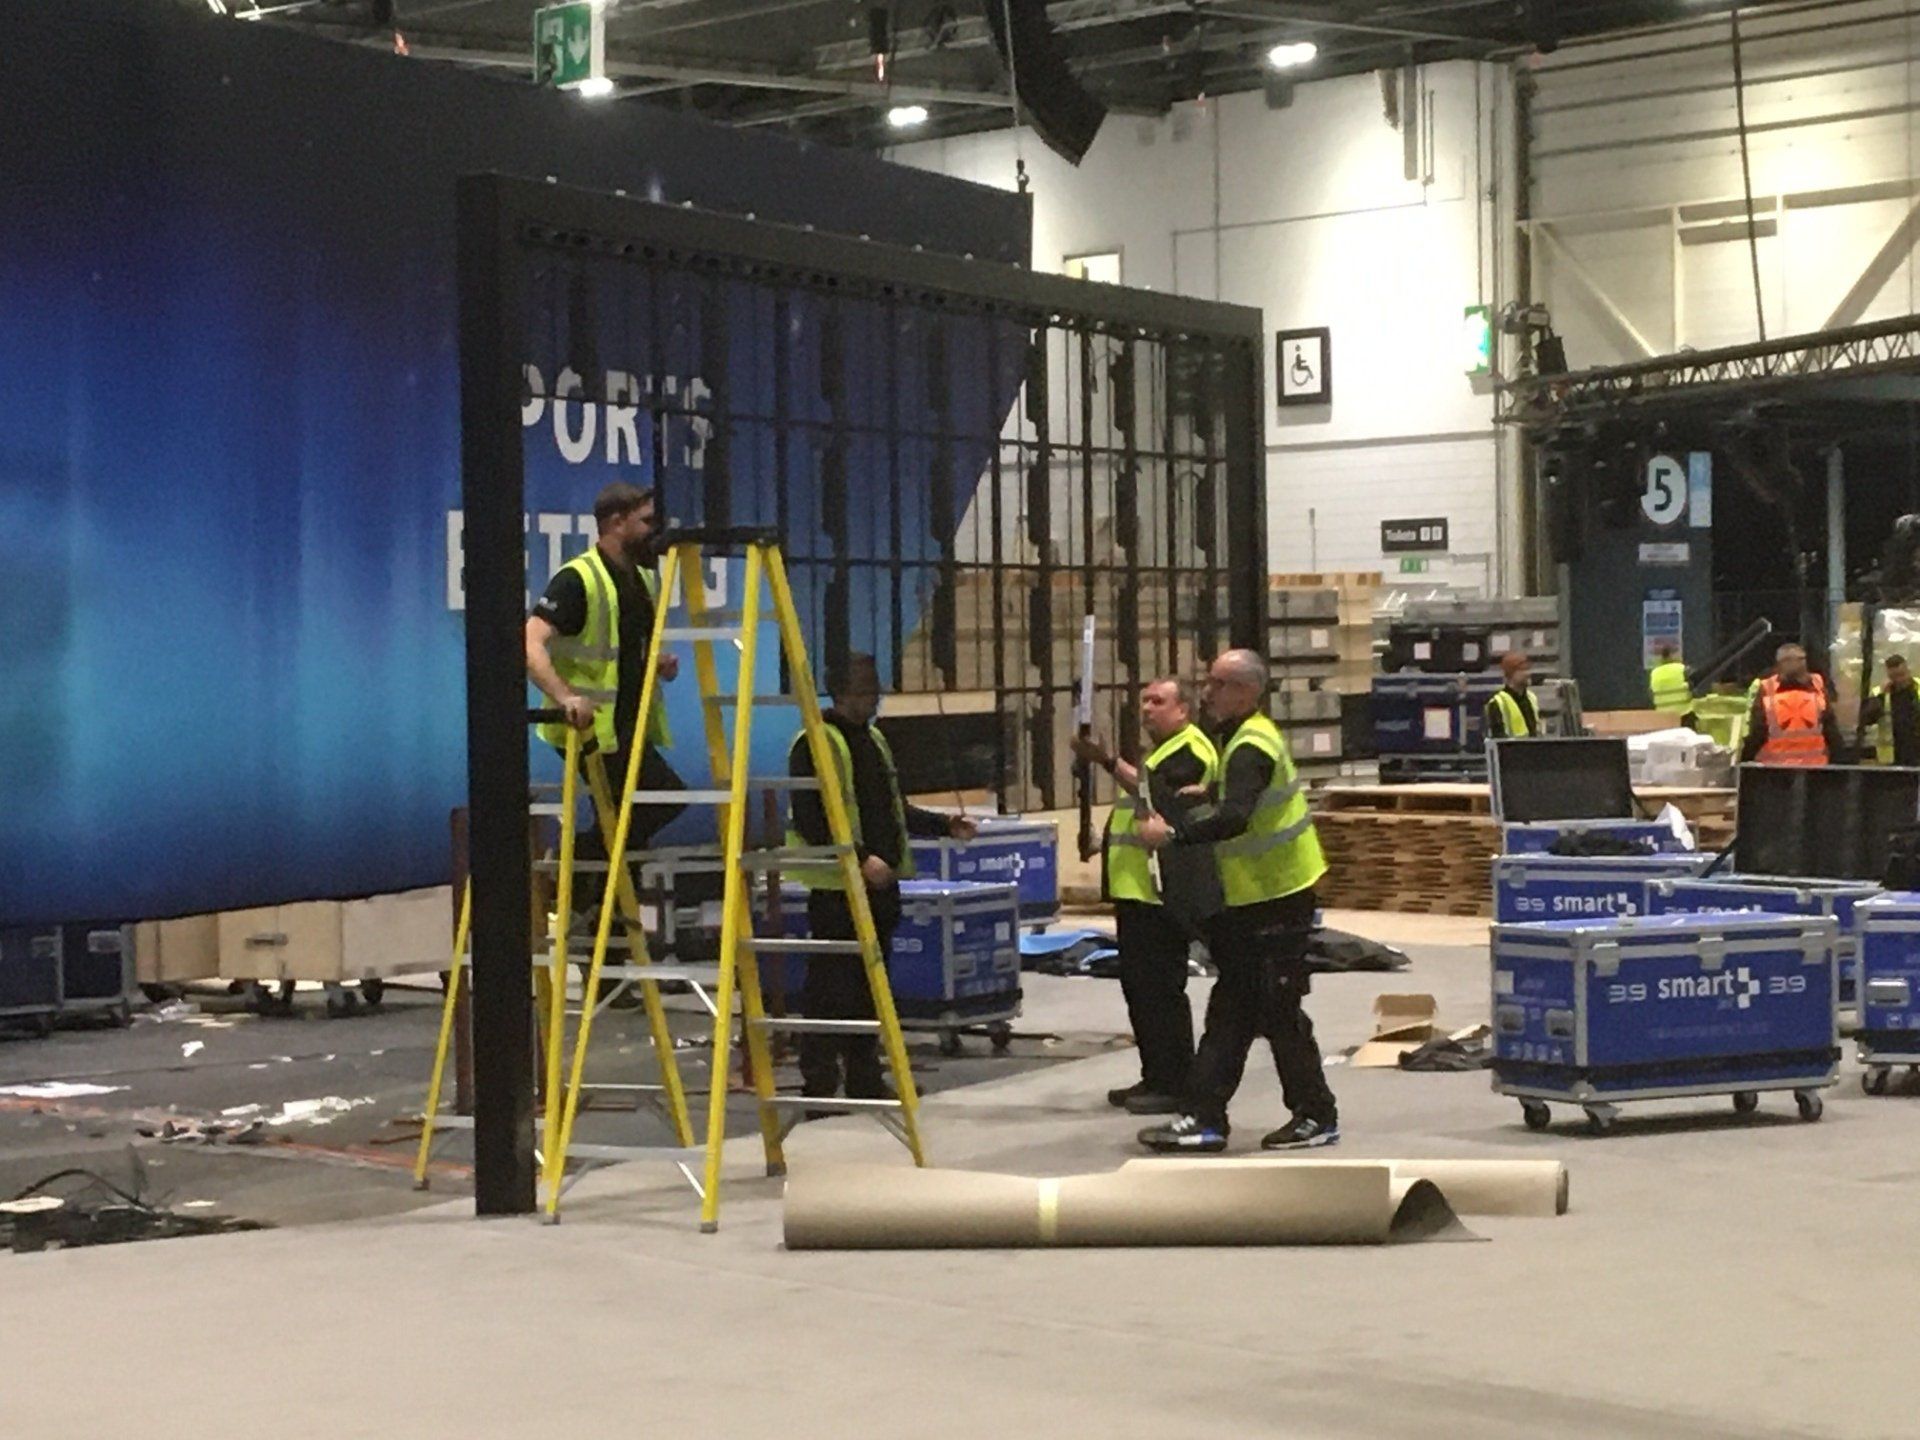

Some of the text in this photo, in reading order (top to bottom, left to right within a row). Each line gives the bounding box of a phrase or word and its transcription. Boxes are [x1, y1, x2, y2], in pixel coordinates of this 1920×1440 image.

[1654, 467, 1672, 512] 5
[1553, 893, 1616, 913] smart
[1658, 970, 1734, 999] smart
